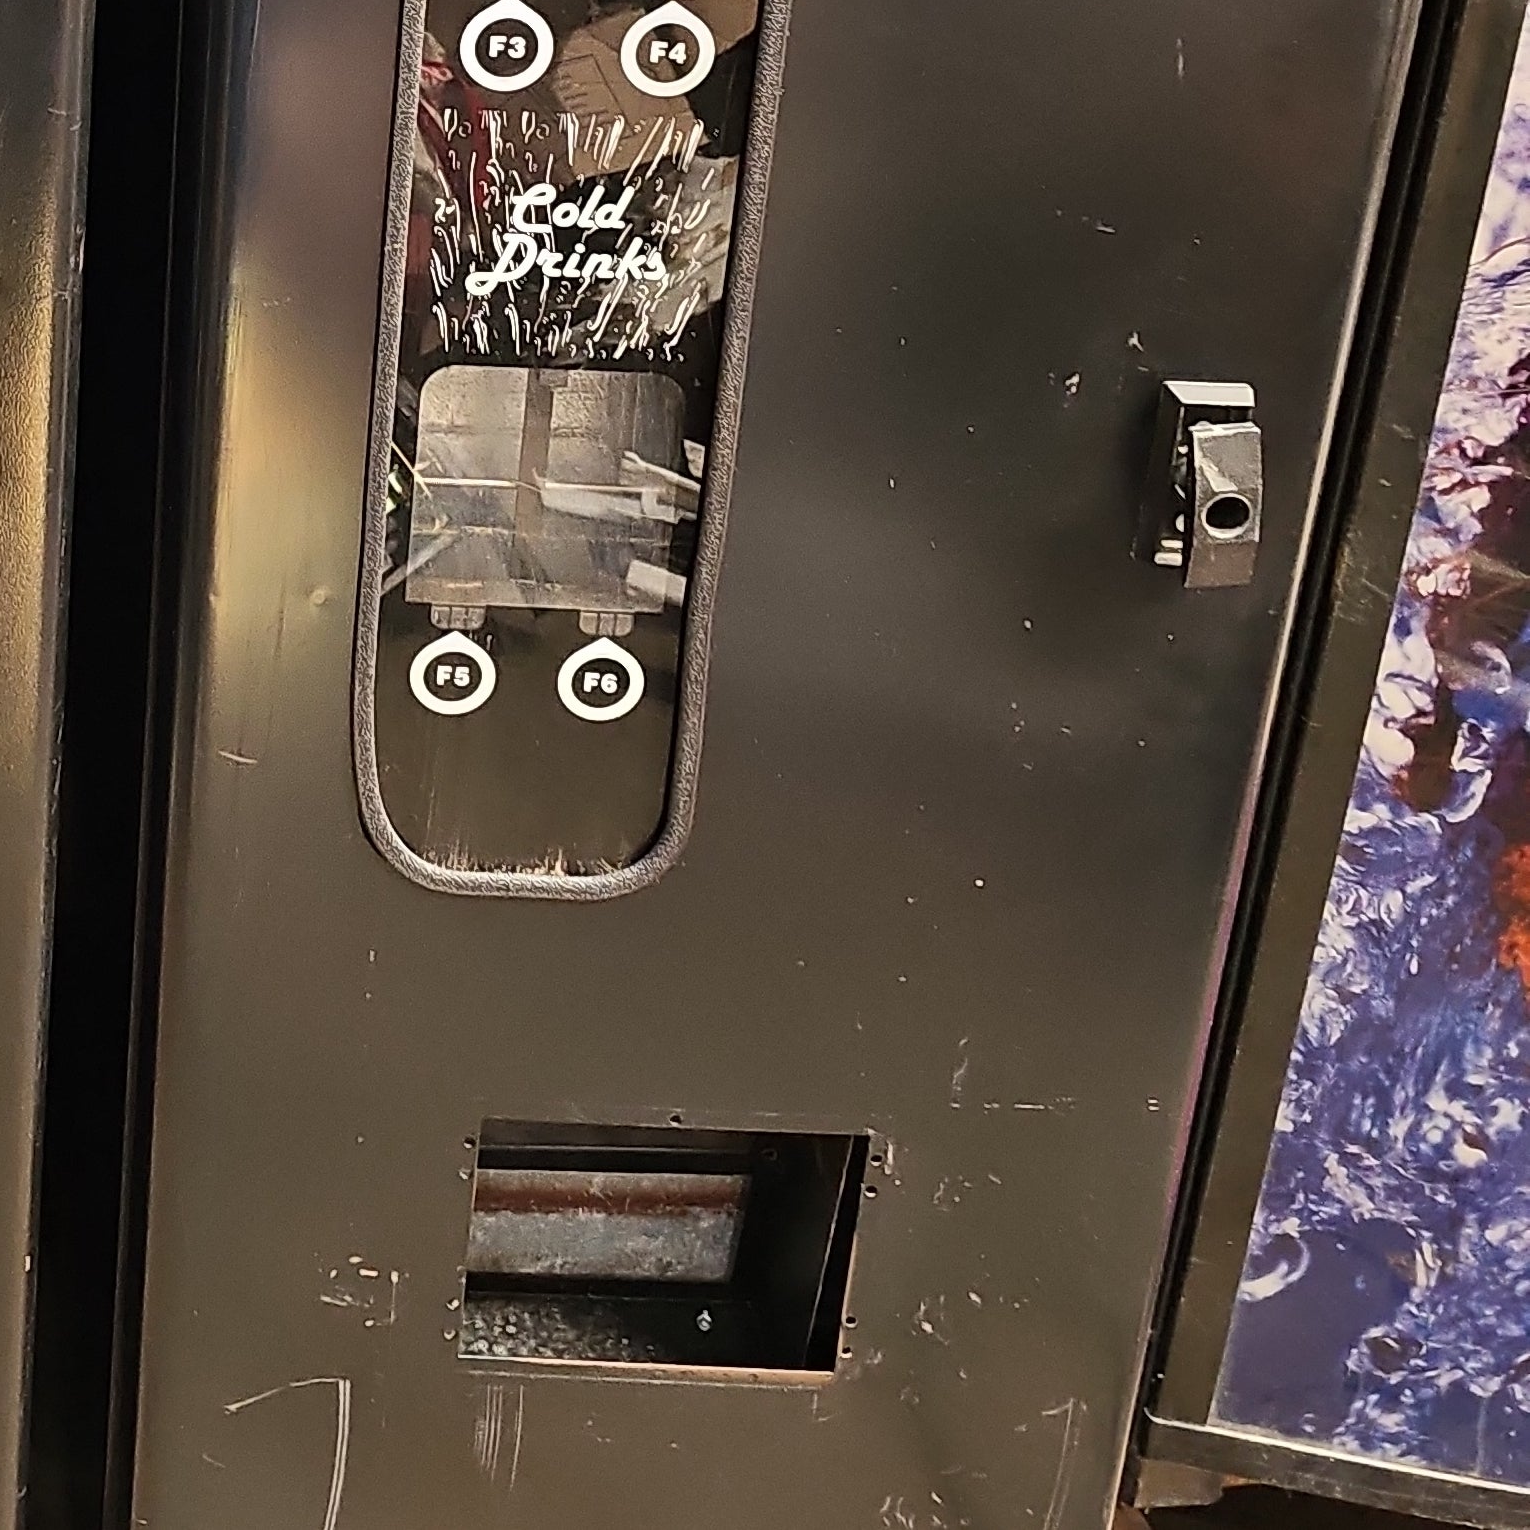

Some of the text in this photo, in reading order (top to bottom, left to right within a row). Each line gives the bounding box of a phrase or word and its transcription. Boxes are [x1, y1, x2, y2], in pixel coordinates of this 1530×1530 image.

[489, 35, 687, 66] F3 F4
[510, 182, 636, 235] Cold
[465, 233, 667, 296] Drinks
[436, 665, 618, 695] F5 F6
